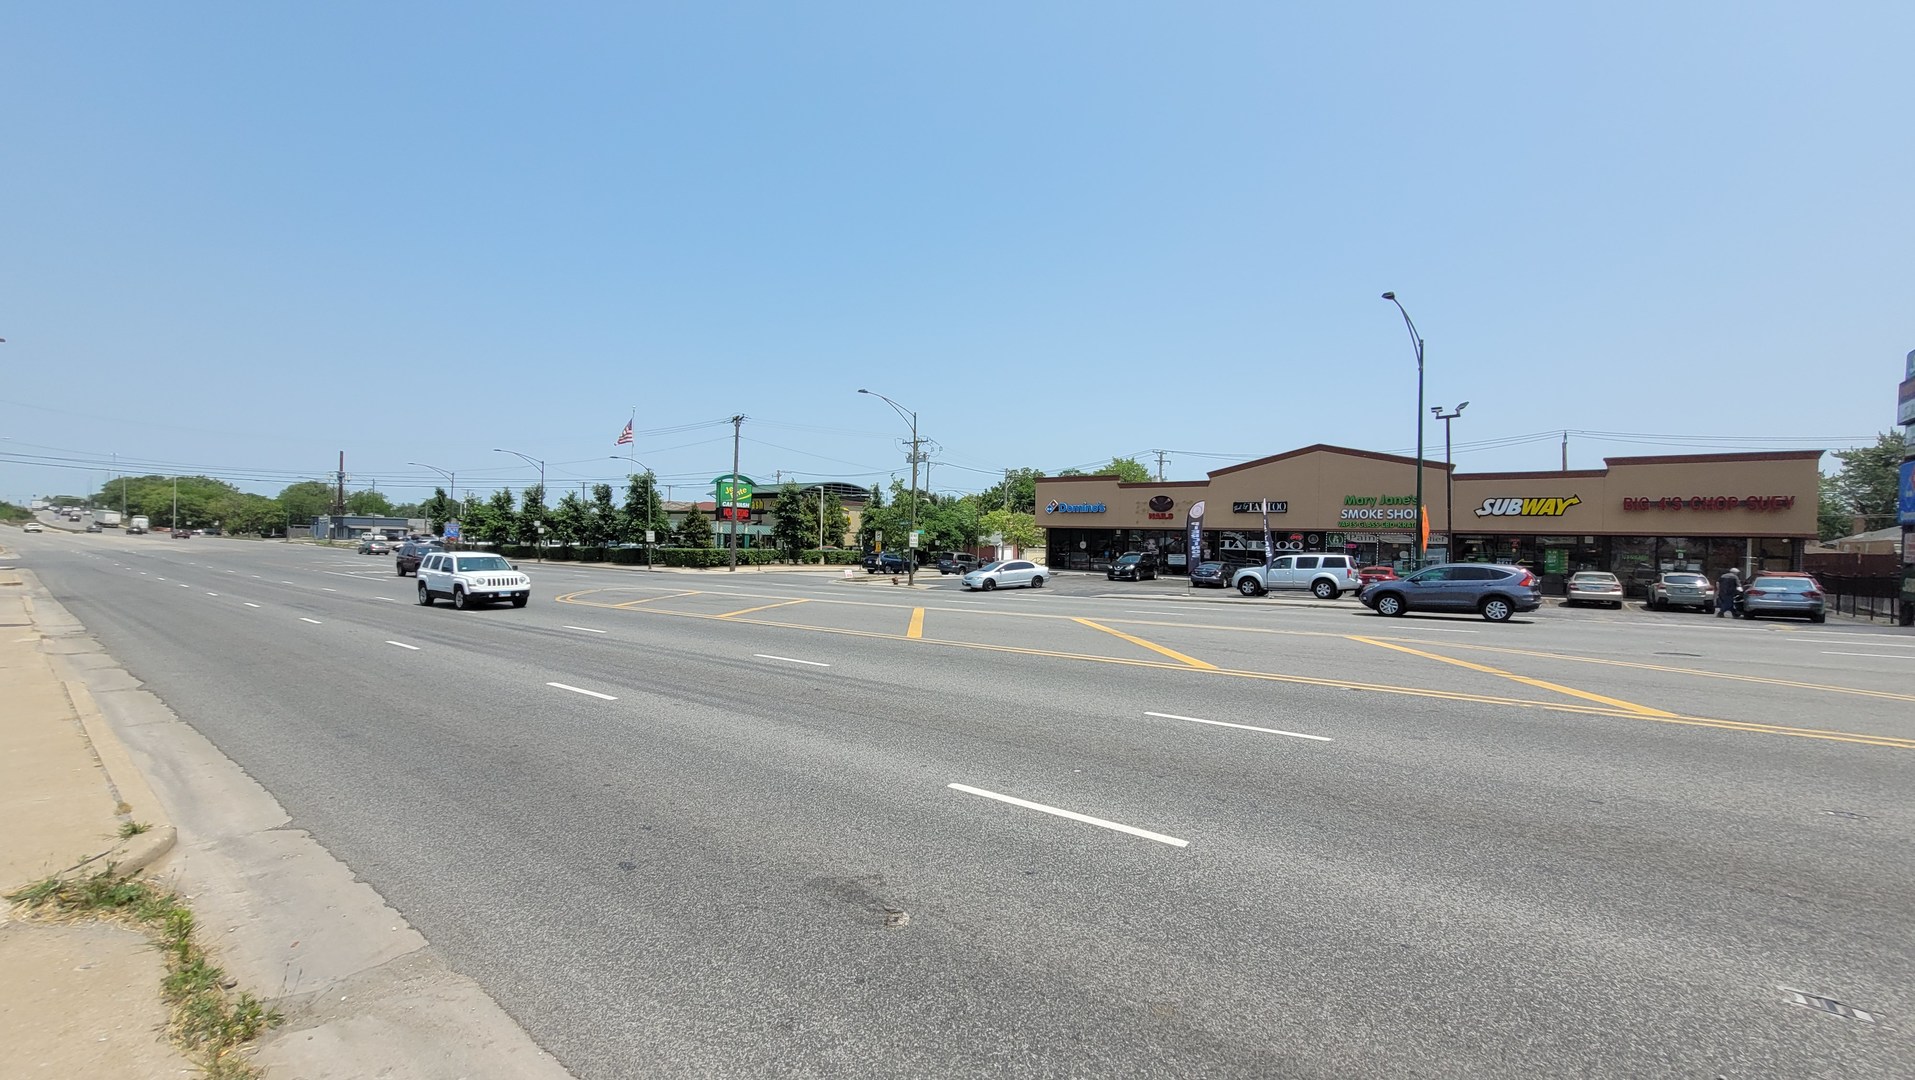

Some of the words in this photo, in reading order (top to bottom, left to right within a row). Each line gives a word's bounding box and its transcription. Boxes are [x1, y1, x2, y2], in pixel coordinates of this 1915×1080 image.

[1344, 494, 1377, 507] Mary
[1379, 494, 1417, 506] Jane's
[1475, 496, 1578, 517] SUBWAY
[1623, 496, 1650, 511] BIG
[1689, 495, 1739, 511] CHOP
[1745, 495, 1796, 511] SUEY
[1059, 501, 1106, 513] Domino's
[1340, 508, 1384, 520] SMOKE
[1349, 533, 1376, 541] Pain
[1220, 540, 1304, 550] TATOO
